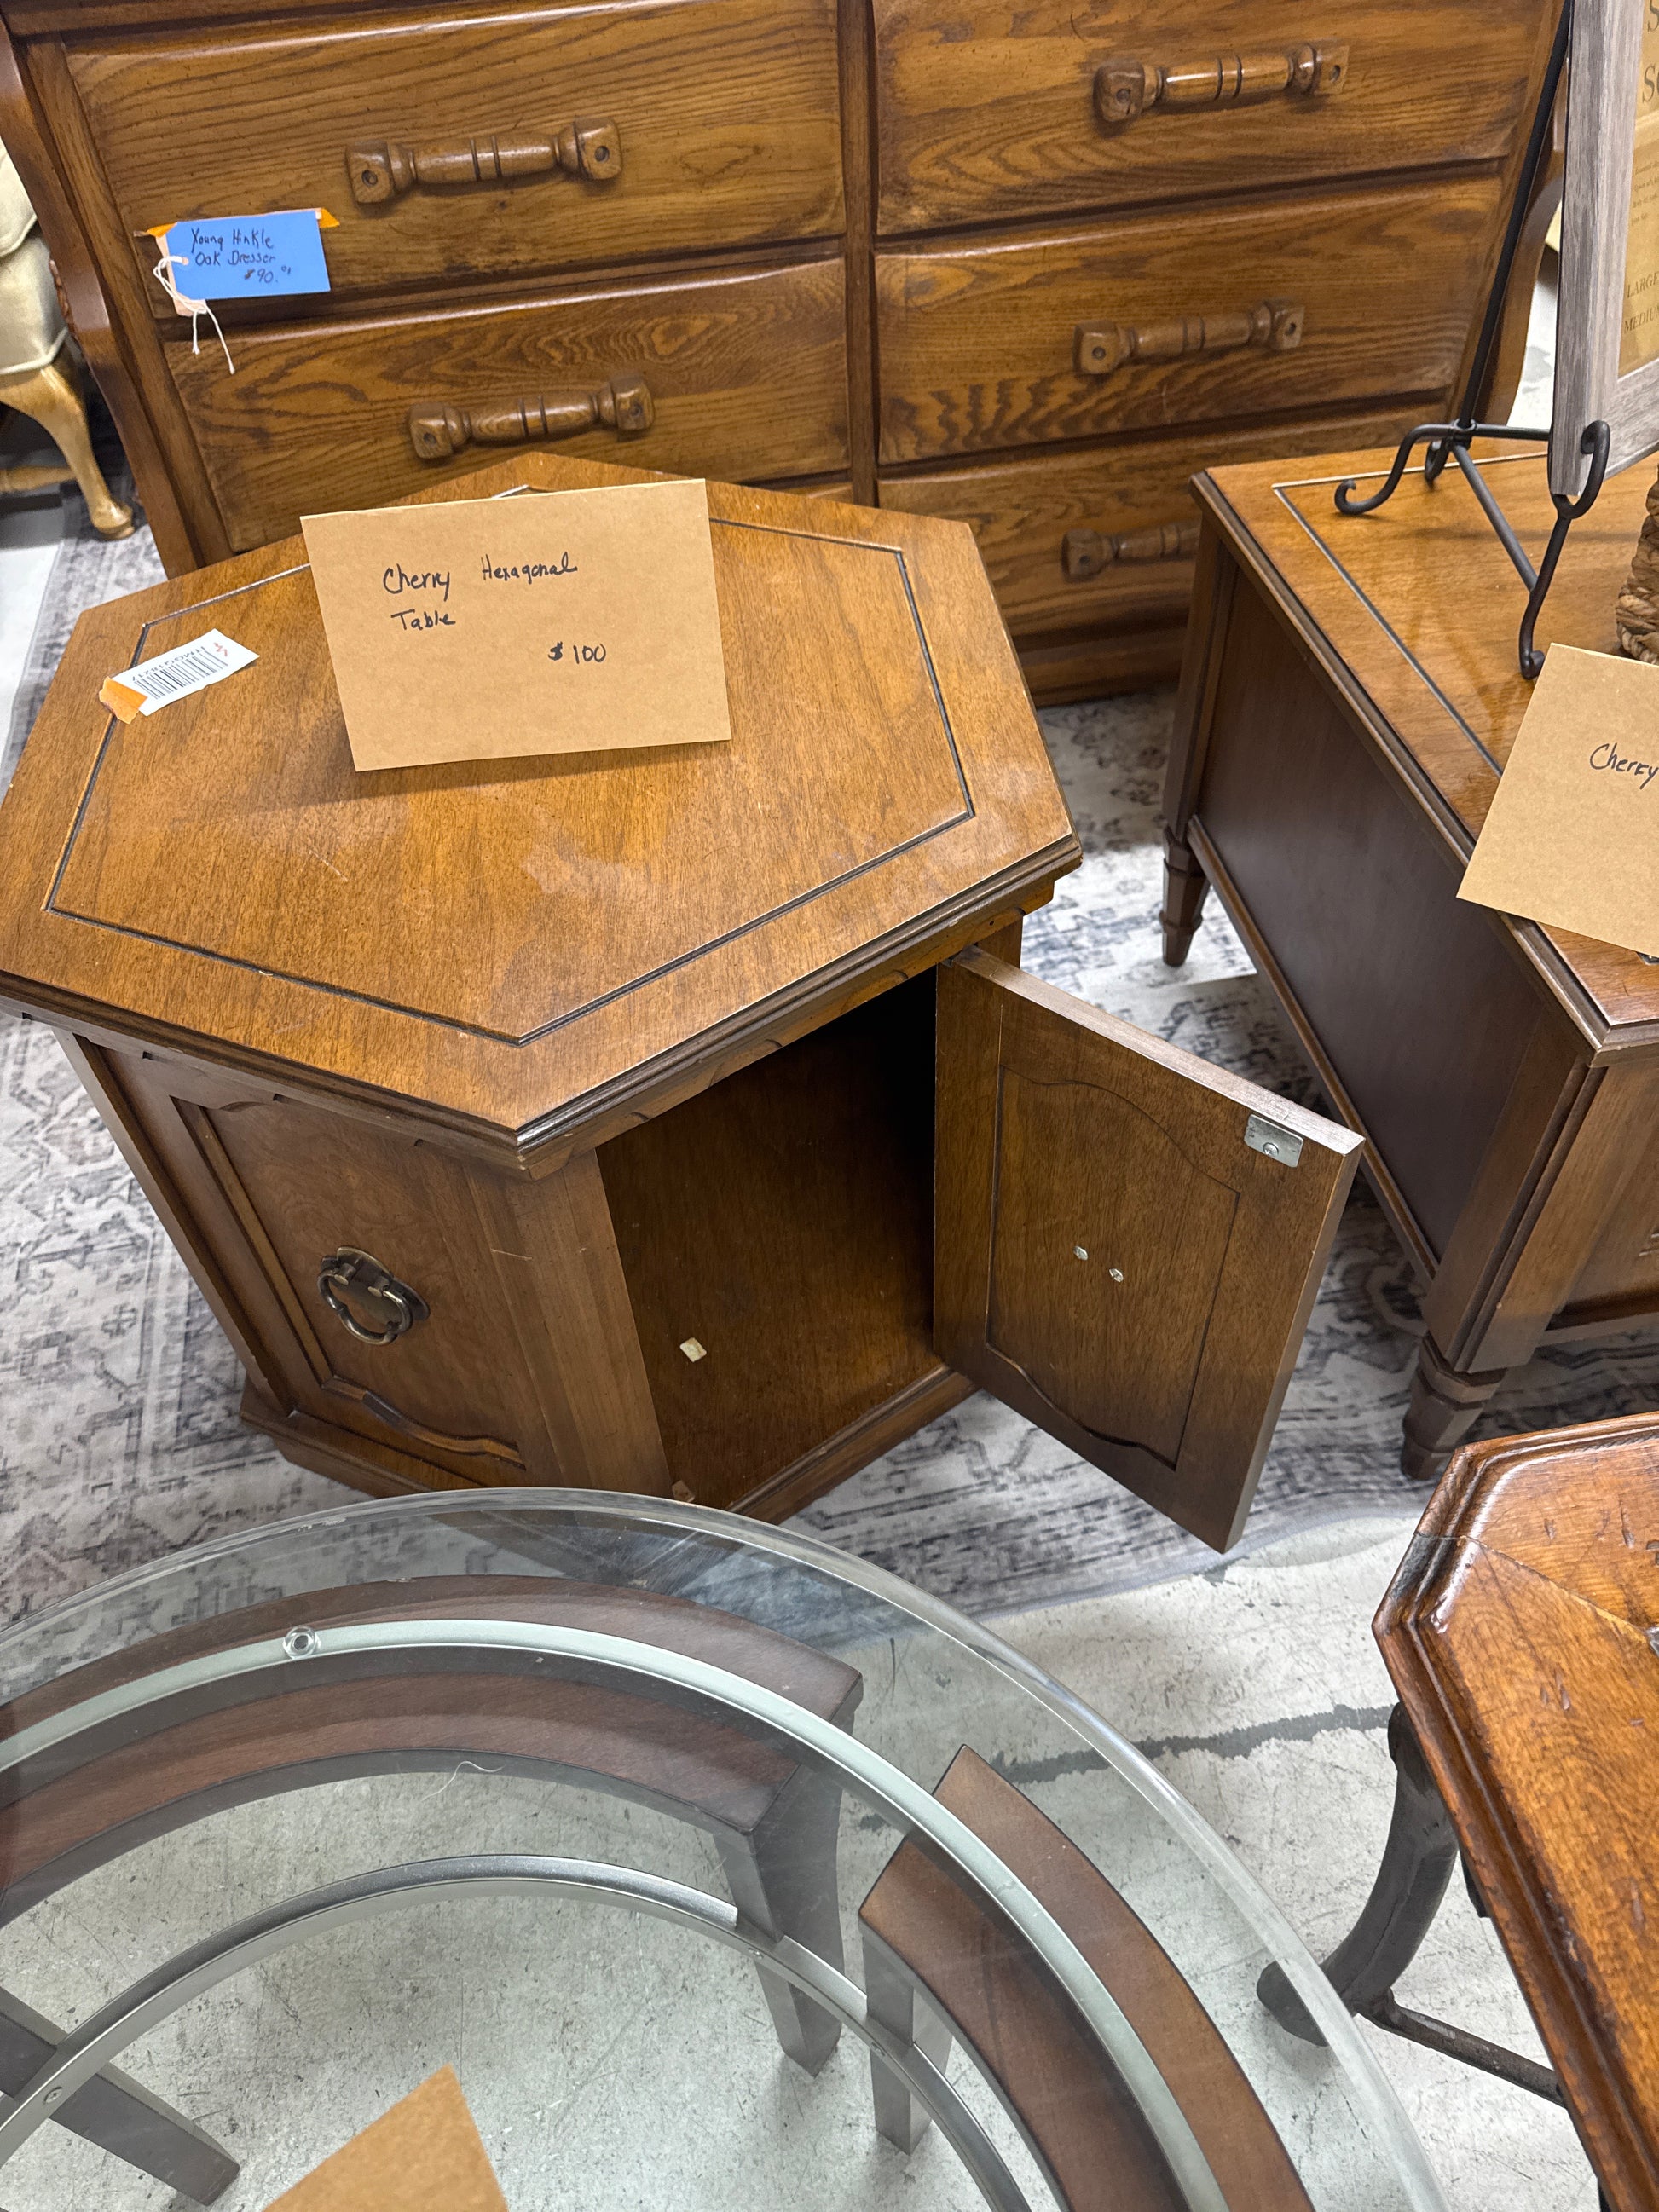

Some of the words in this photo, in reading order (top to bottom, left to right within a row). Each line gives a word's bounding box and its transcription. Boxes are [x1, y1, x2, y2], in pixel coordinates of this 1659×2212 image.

[191, 228, 223, 253] Young
[228, 250, 275, 265] Dresser
[1623, 303, 1659, 333] MEDIU
[383, 563, 450, 602] Cherry
[481, 552, 578, 585] Hexagonal
[390, 609, 456, 630] Table
[1589, 742, 1659, 790] Cherry
